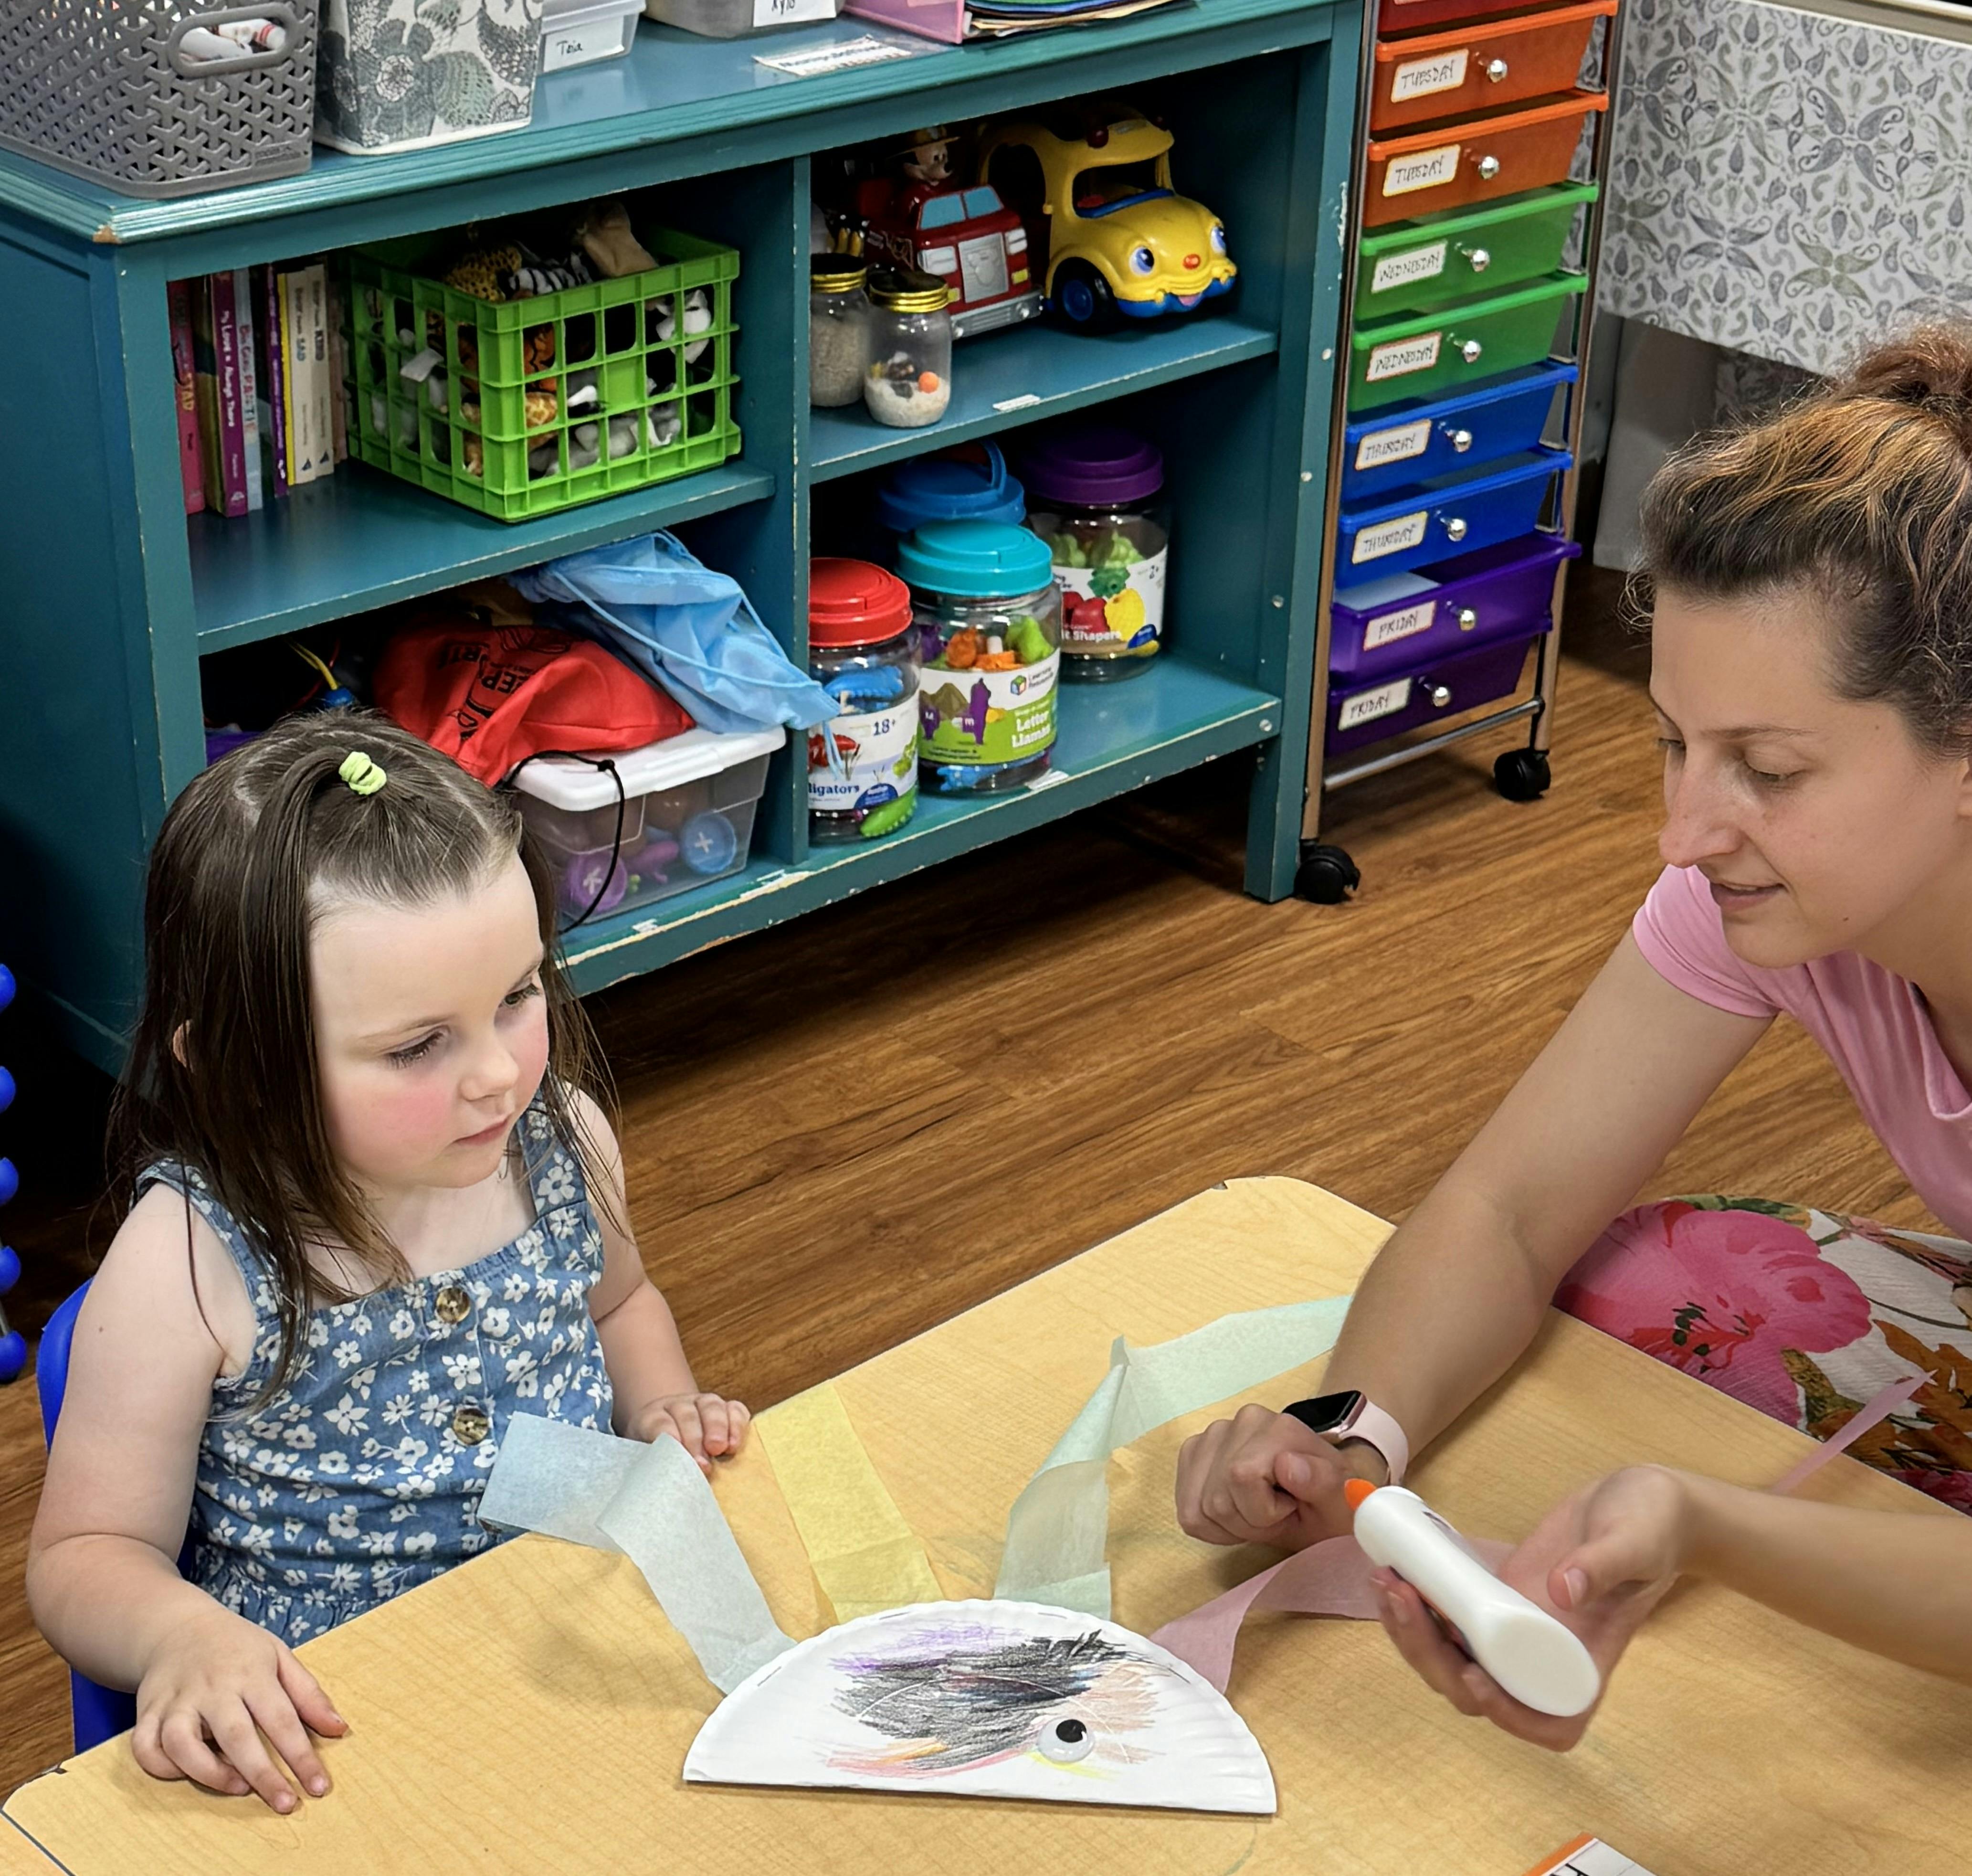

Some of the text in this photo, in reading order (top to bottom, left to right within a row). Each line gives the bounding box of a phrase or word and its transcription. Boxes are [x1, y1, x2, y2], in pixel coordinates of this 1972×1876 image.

[1402, 59, 1455, 89] TUESDAY
[1395, 155, 1444, 183] TUESDAY
[1379, 251, 1440, 282] WEDNESDAY
[1365, 433, 1416, 460] THURSDAY
[1363, 524, 1416, 552] THURSDAY
[1073, 630, 1121, 643] Shapers
[1378, 610, 1418, 639] FRIDAY
[1350, 691, 1390, 719] FRIDAY
[1016, 711, 1049, 732] Letter
[1012, 724, 1051, 748] Llamas
